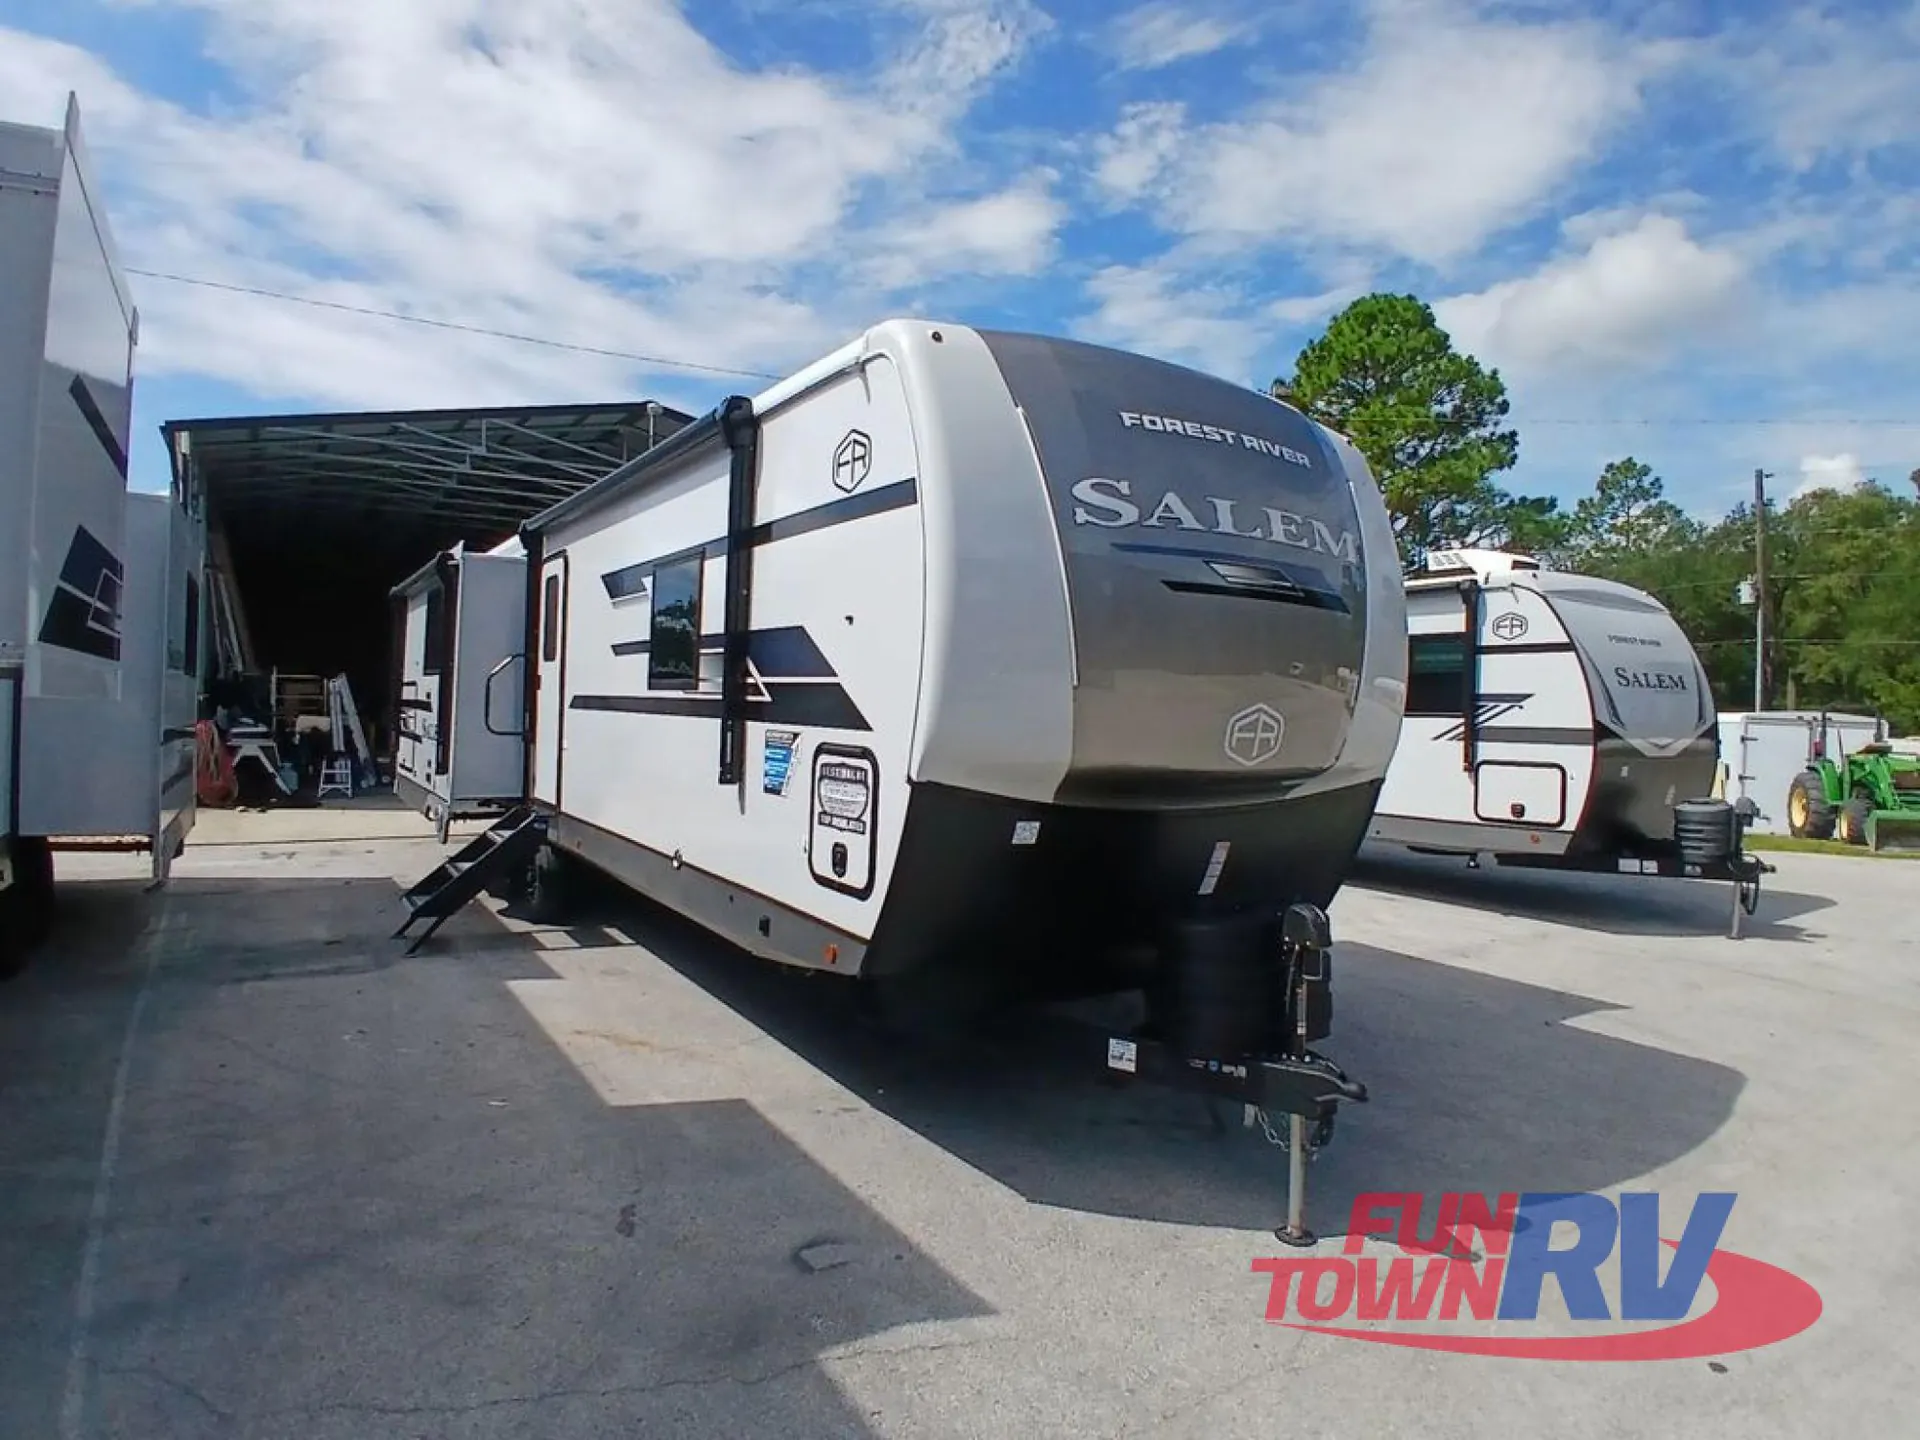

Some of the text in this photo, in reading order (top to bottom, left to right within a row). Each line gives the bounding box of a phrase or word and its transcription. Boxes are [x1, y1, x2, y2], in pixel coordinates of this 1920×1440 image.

[1119, 411, 1312, 469] FOREST RIVER
[1071, 476, 1359, 564] SALEM
[1613, 665, 1687, 691] SALEM
